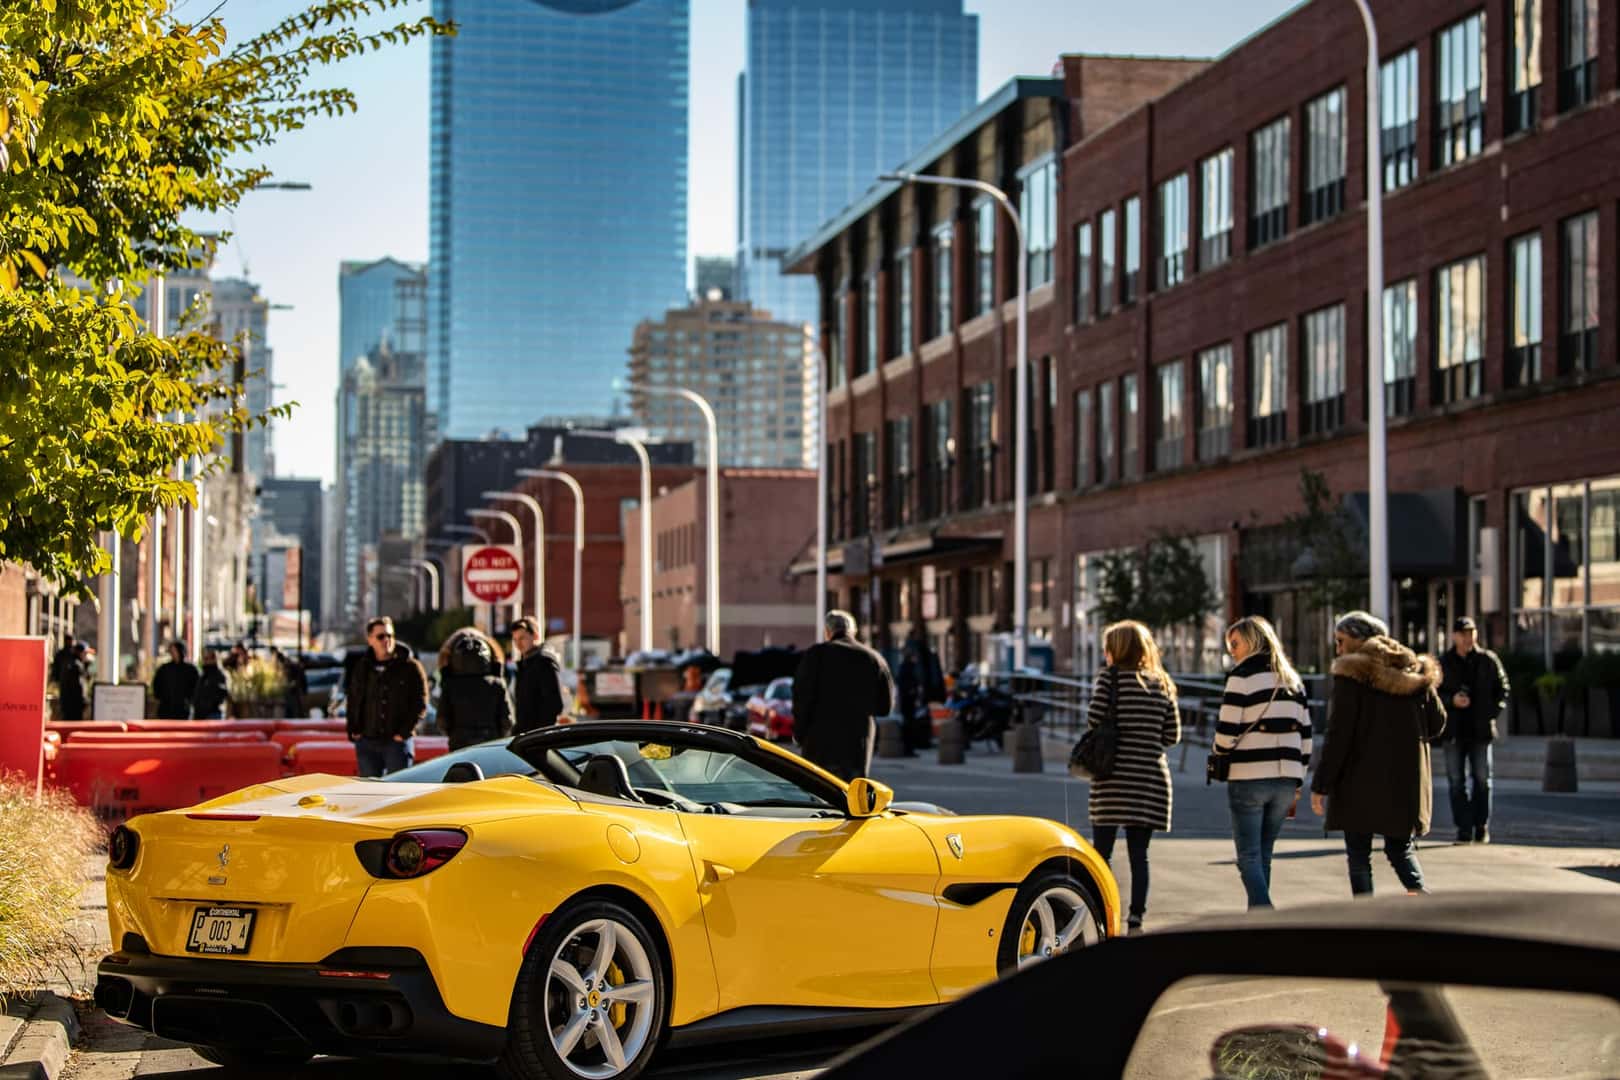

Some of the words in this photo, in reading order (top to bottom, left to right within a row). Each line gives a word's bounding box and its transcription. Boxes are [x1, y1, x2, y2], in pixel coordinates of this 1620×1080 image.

[471, 557, 487, 568] DO
[491, 557, 513, 568] NOT
[475, 583, 510, 593] ENTER
[208, 919, 232, 941] 003
[239, 924, 246, 939] A
